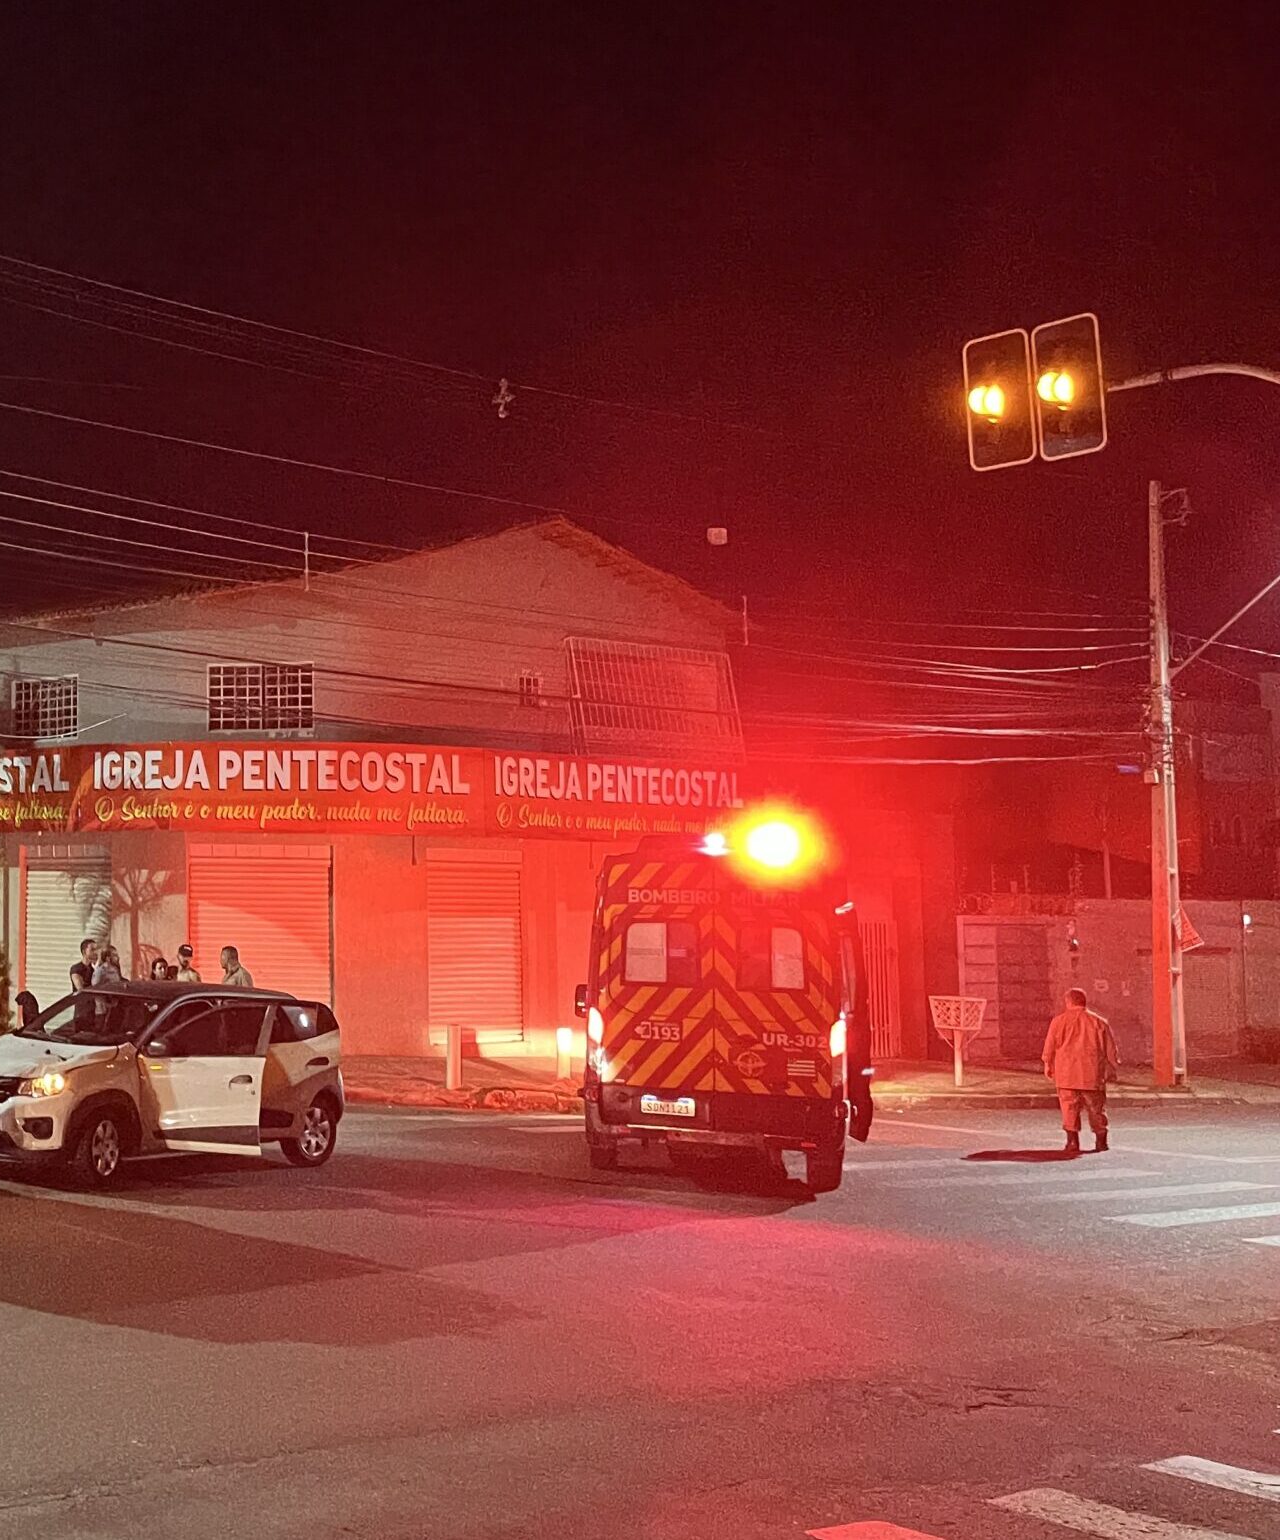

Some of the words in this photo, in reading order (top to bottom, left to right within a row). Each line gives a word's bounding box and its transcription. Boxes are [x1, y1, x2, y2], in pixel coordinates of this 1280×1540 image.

[93, 749, 211, 790] IGREJA
[218, 749, 470, 794] PENTECOSTAL
[494, 755, 583, 801] IGREJA
[587, 763, 744, 808] PENTECOSTAL
[95, 796, 114, 822] O
[121, 796, 179, 821] Senhor
[200, 805, 211, 819] o
[216, 804, 256, 819] meu
[326, 801, 370, 821] nada
[376, 806, 401, 821] me
[496, 802, 512, 828] O
[519, 804, 561, 828] Senhor
[575, 816, 581, 828] o
[586, 816, 610, 830] meu
[628, 888, 720, 905] BOMBEIRO
[651, 1026, 680, 1041] 193
[762, 1032, 828, 1049] UR-302
